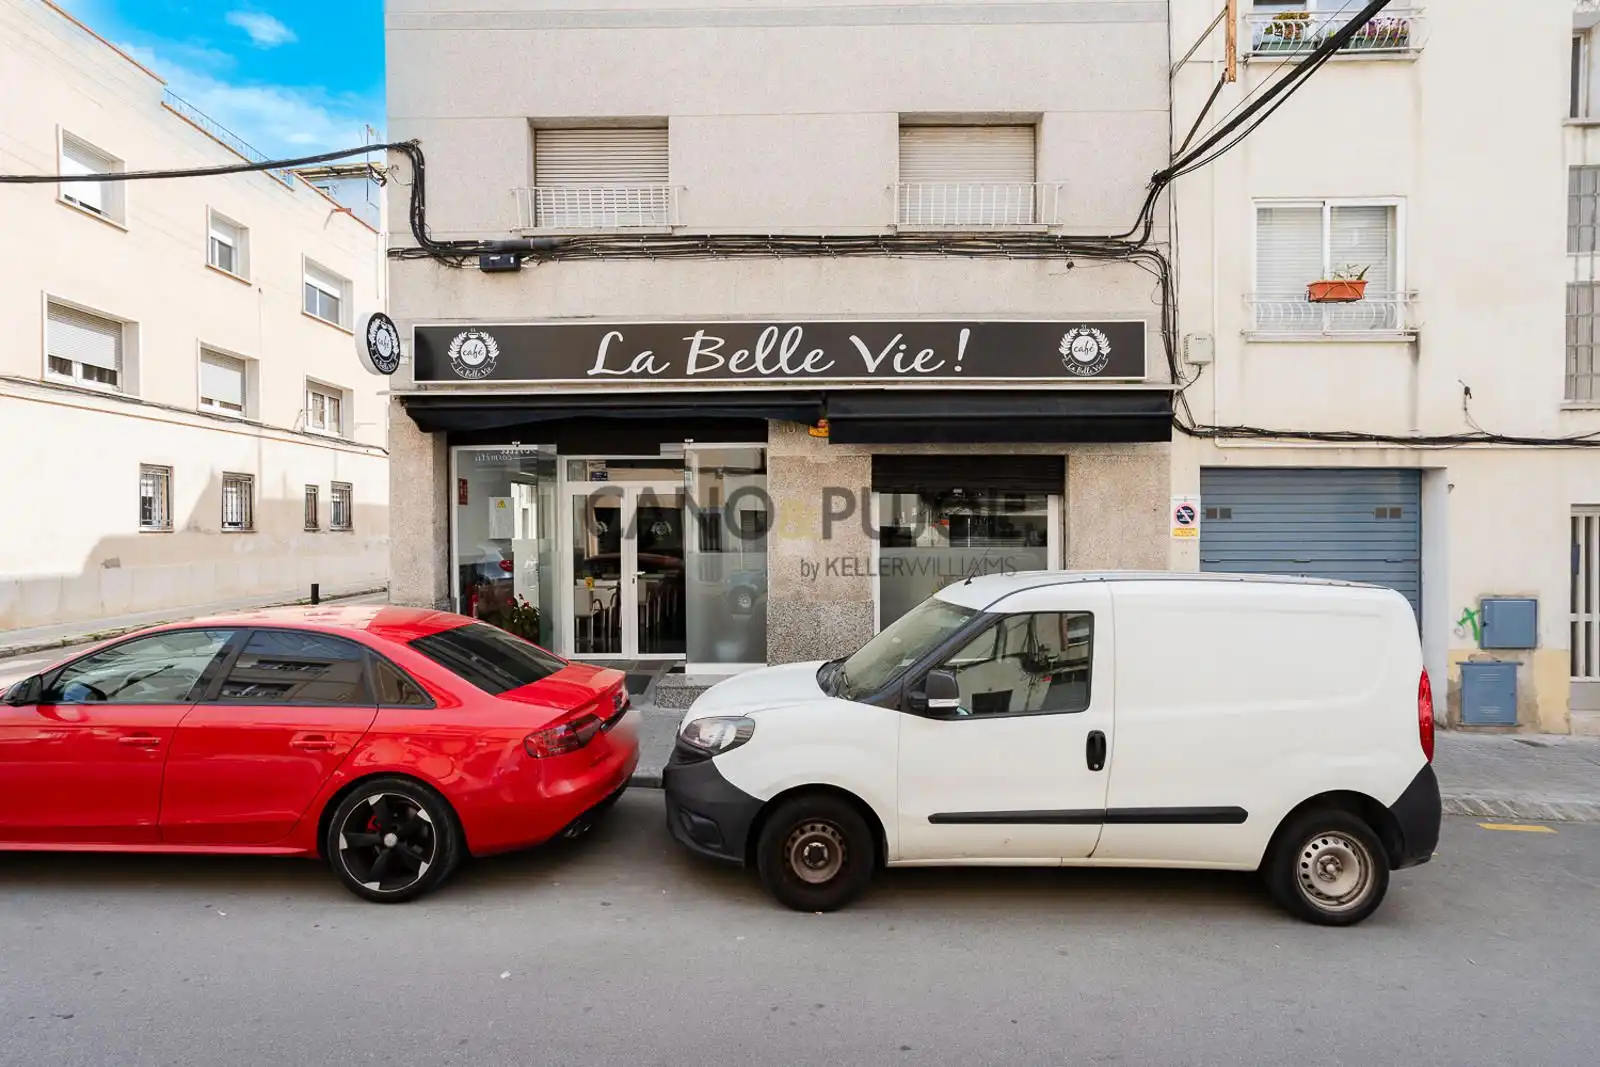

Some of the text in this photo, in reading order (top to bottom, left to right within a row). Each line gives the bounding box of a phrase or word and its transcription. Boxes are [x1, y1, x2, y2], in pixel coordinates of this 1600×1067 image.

[463, 344, 484, 359] café
[587, 331, 670, 376] La
[682, 325, 835, 375] Belle
[1073, 340, 1096, 356] café
